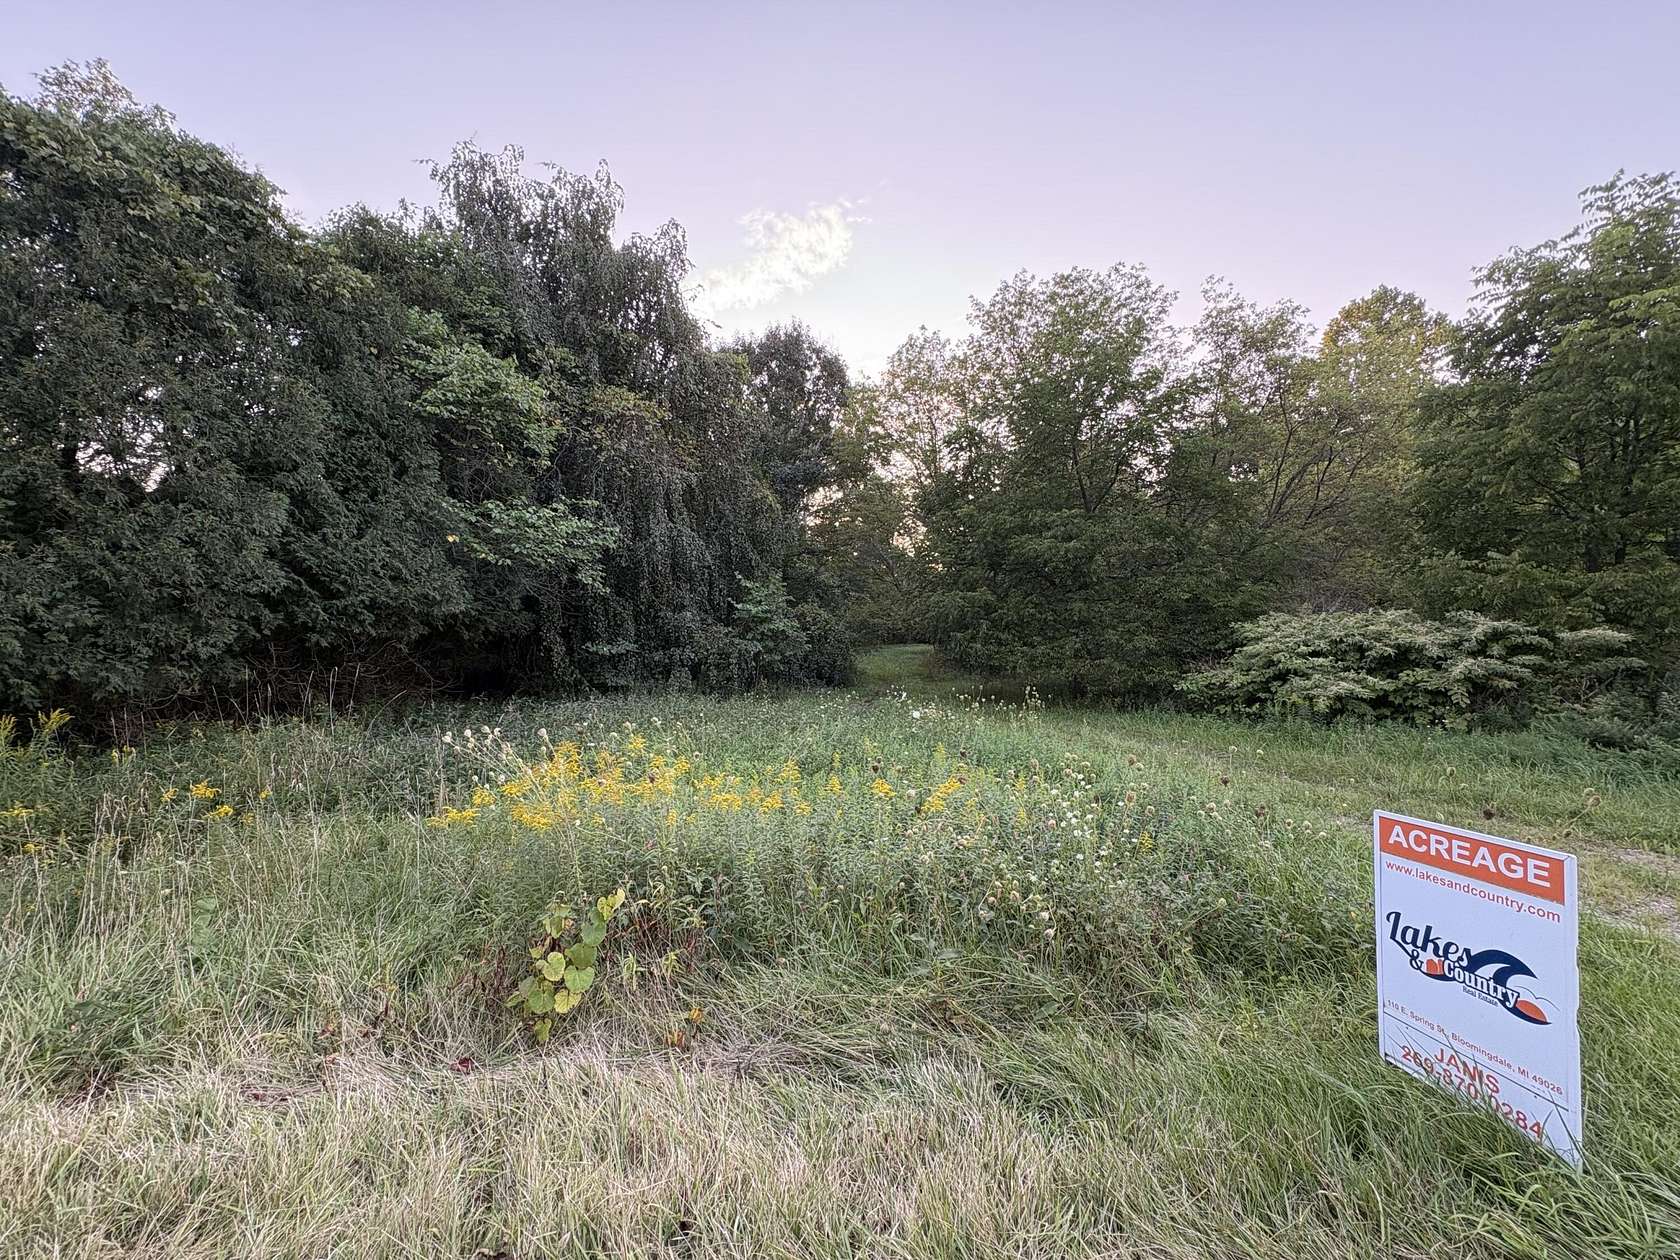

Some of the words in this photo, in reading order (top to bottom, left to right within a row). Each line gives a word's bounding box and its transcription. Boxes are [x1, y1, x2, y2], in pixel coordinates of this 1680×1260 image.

[1388, 825, 1551, 888] ACREAGE
[1385, 860, 1561, 923] www.lakesandcountry.com
[1386, 911, 1472, 967] Lakes
[1409, 949, 1424, 971] &
[1443, 958, 1520, 1008] Country
[1462, 985, 1477, 998] Real
[1477, 990, 1499, 1007] Estate
[1387, 999, 1400, 1010] 110
[1409, 1011, 1435, 1031] Spring
[1451, 1032, 1515, 1073] Bloomingdale,
[1517, 1066, 1530, 1079] MI
[1531, 1074, 1564, 1096] 49026
[1434, 1047, 1500, 1094] JANIS
